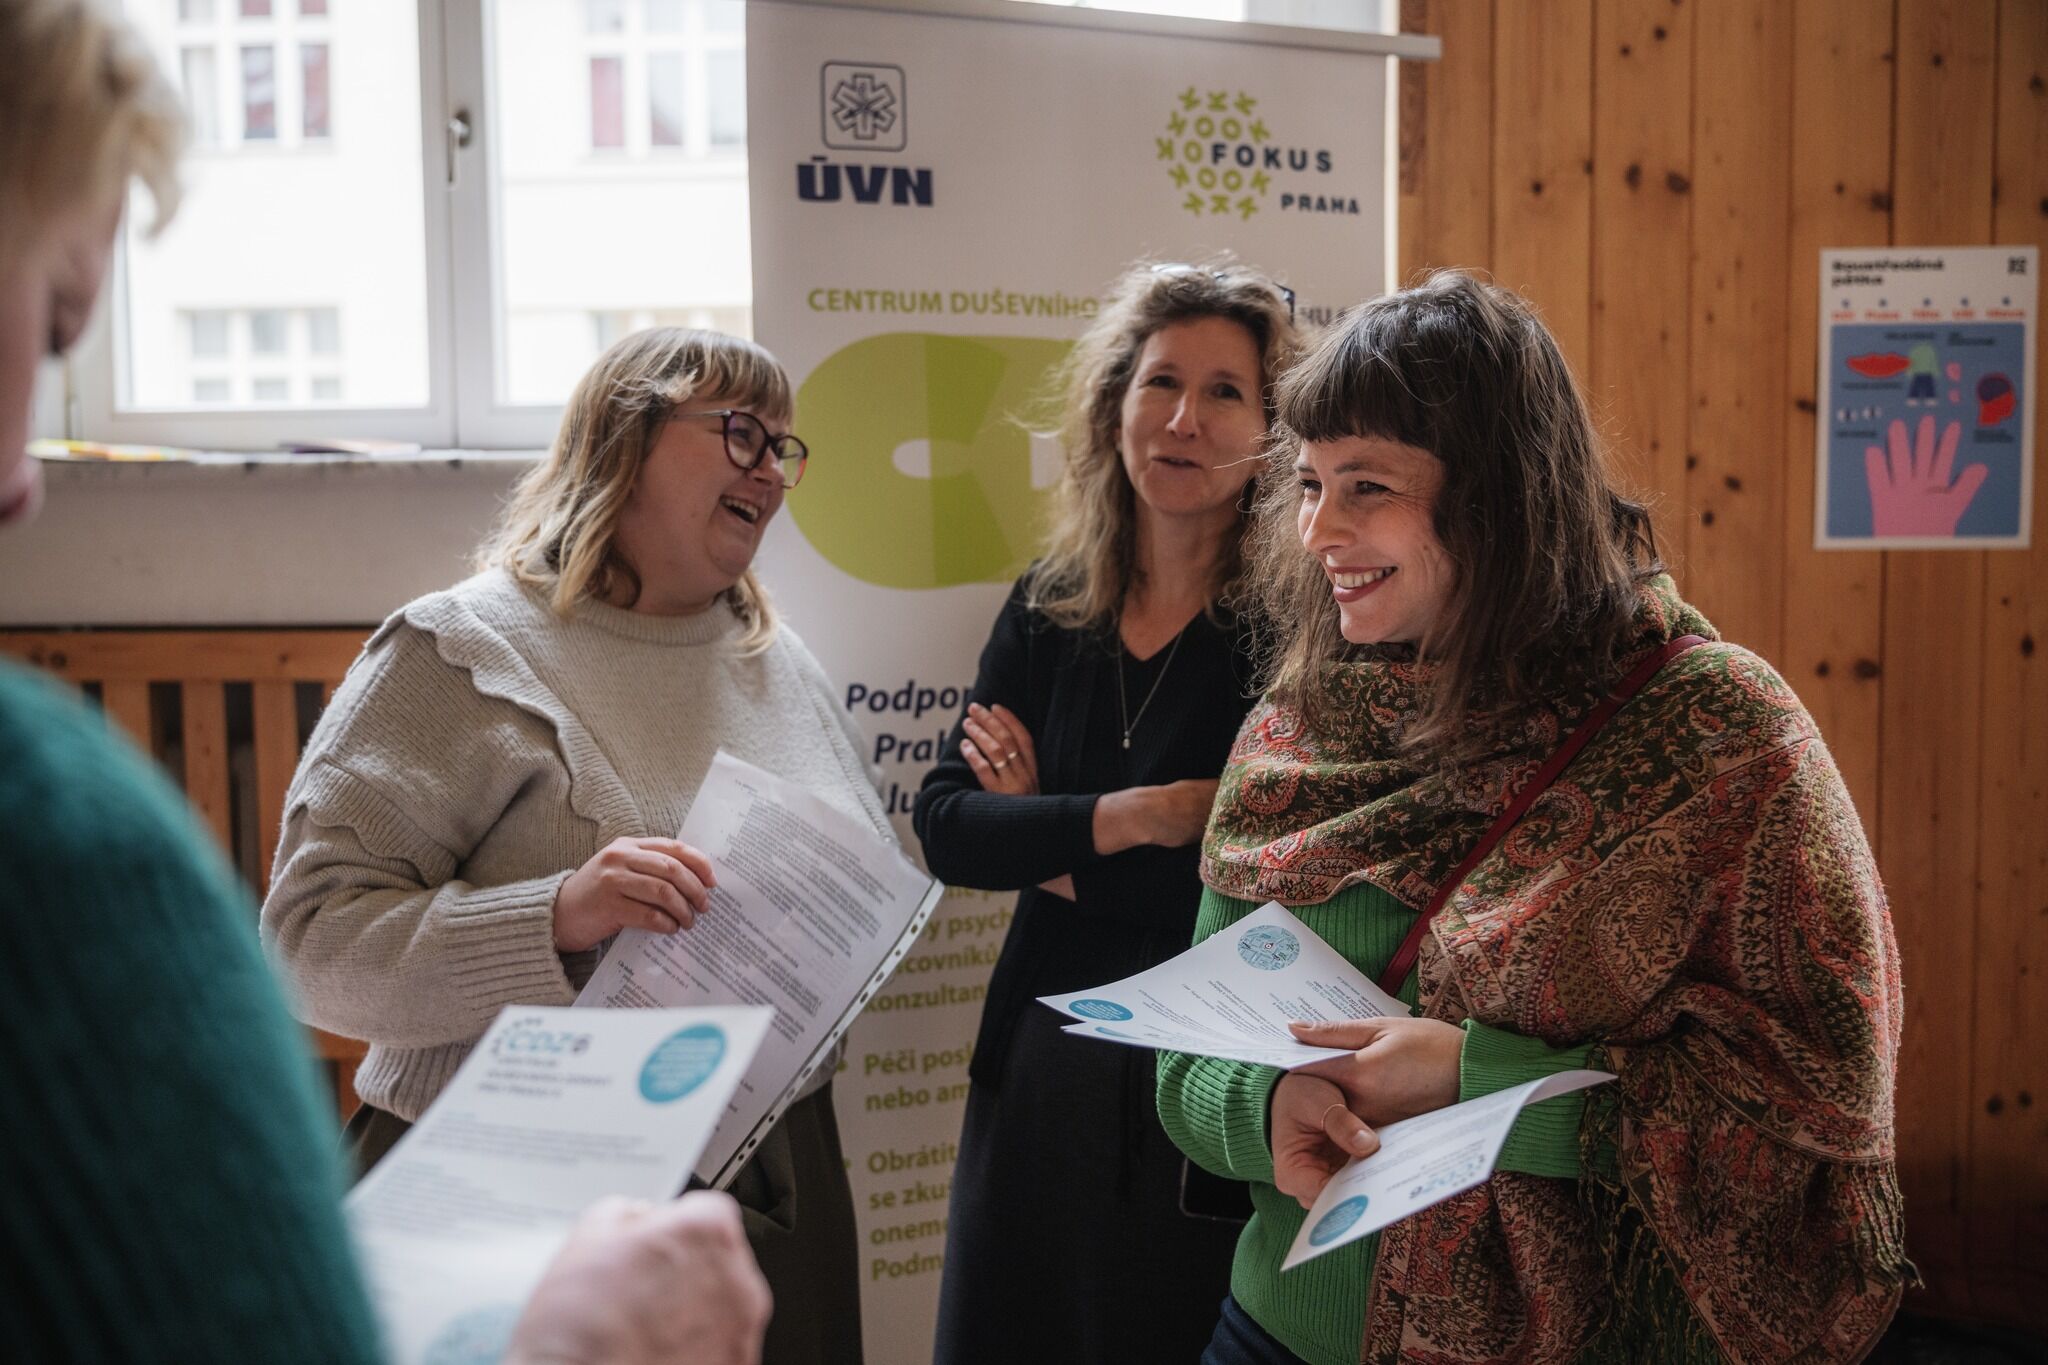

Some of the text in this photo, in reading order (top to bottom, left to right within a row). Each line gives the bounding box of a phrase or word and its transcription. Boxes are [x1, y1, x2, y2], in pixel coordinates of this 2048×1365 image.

[1211, 142, 1332, 173] FOKUS
[1281, 193, 1360, 214] PRAHA
[807, 288, 943, 314] CENTRUM
[951, 289, 1099, 320] DUŠEVNÍHO
[863, 1048, 916, 1076] Péči
[865, 1085, 930, 1112] nebo
[869, 1179, 951, 1212] se zku
